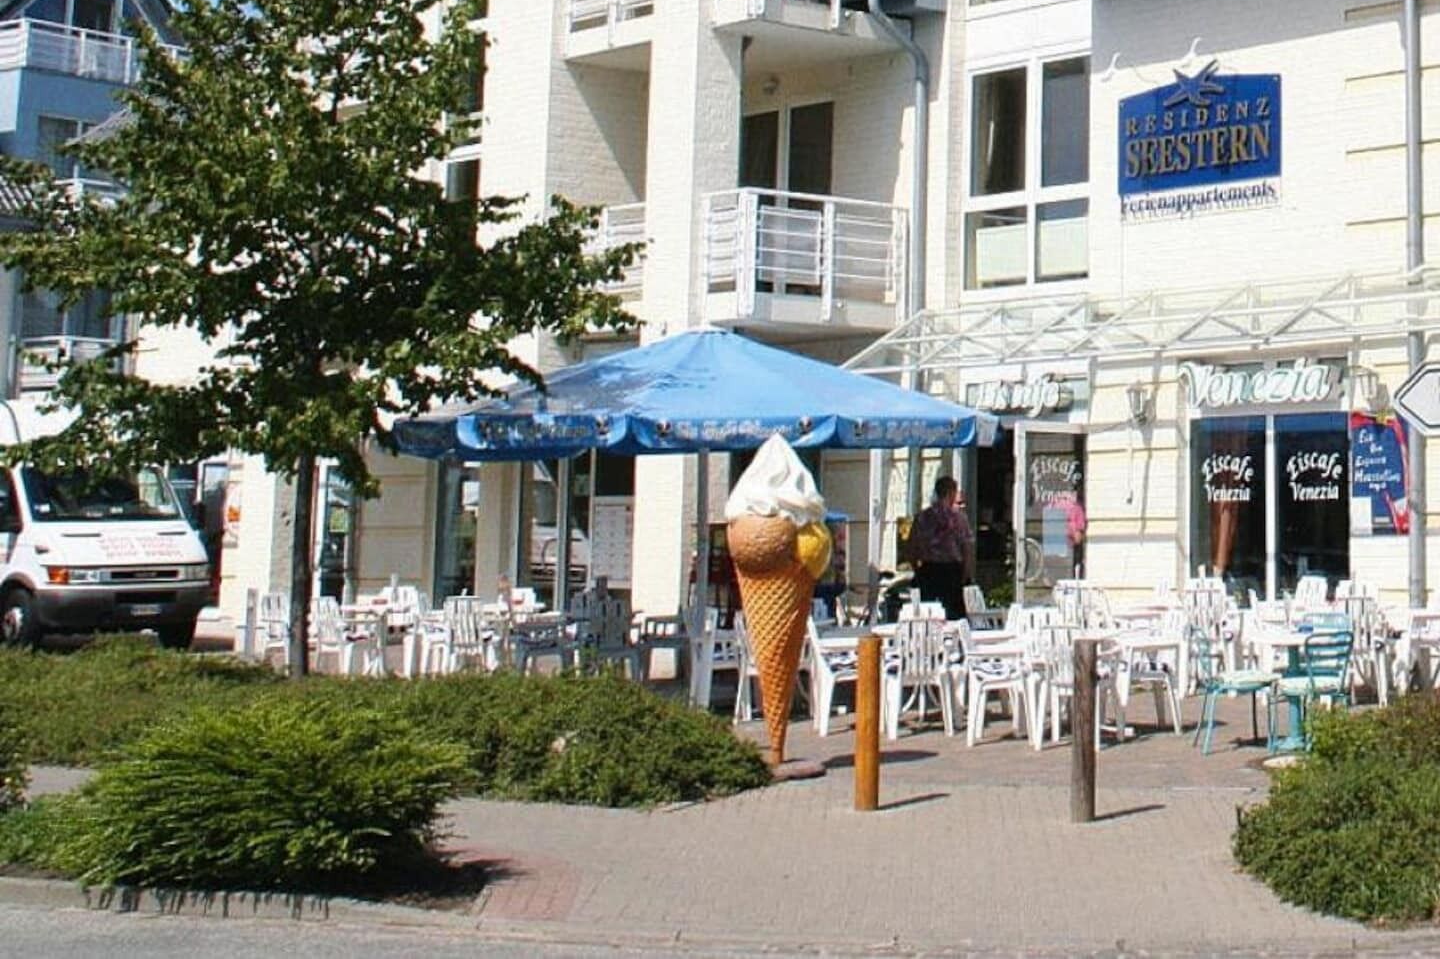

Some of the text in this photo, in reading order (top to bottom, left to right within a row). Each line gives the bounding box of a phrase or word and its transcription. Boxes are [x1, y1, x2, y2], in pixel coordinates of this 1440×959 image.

[1126, 96, 1270, 137] RESIDENZ
[1125, 121, 1271, 177] SEESTERN
[1178, 356, 1332, 409] Venezia
[1202, 452, 1255, 482] Eiscafe
[1286, 451, 1343, 482] Eiscafe
[1204, 482, 1251, 503] Venezia
[1289, 481, 1340, 502] Venezia
